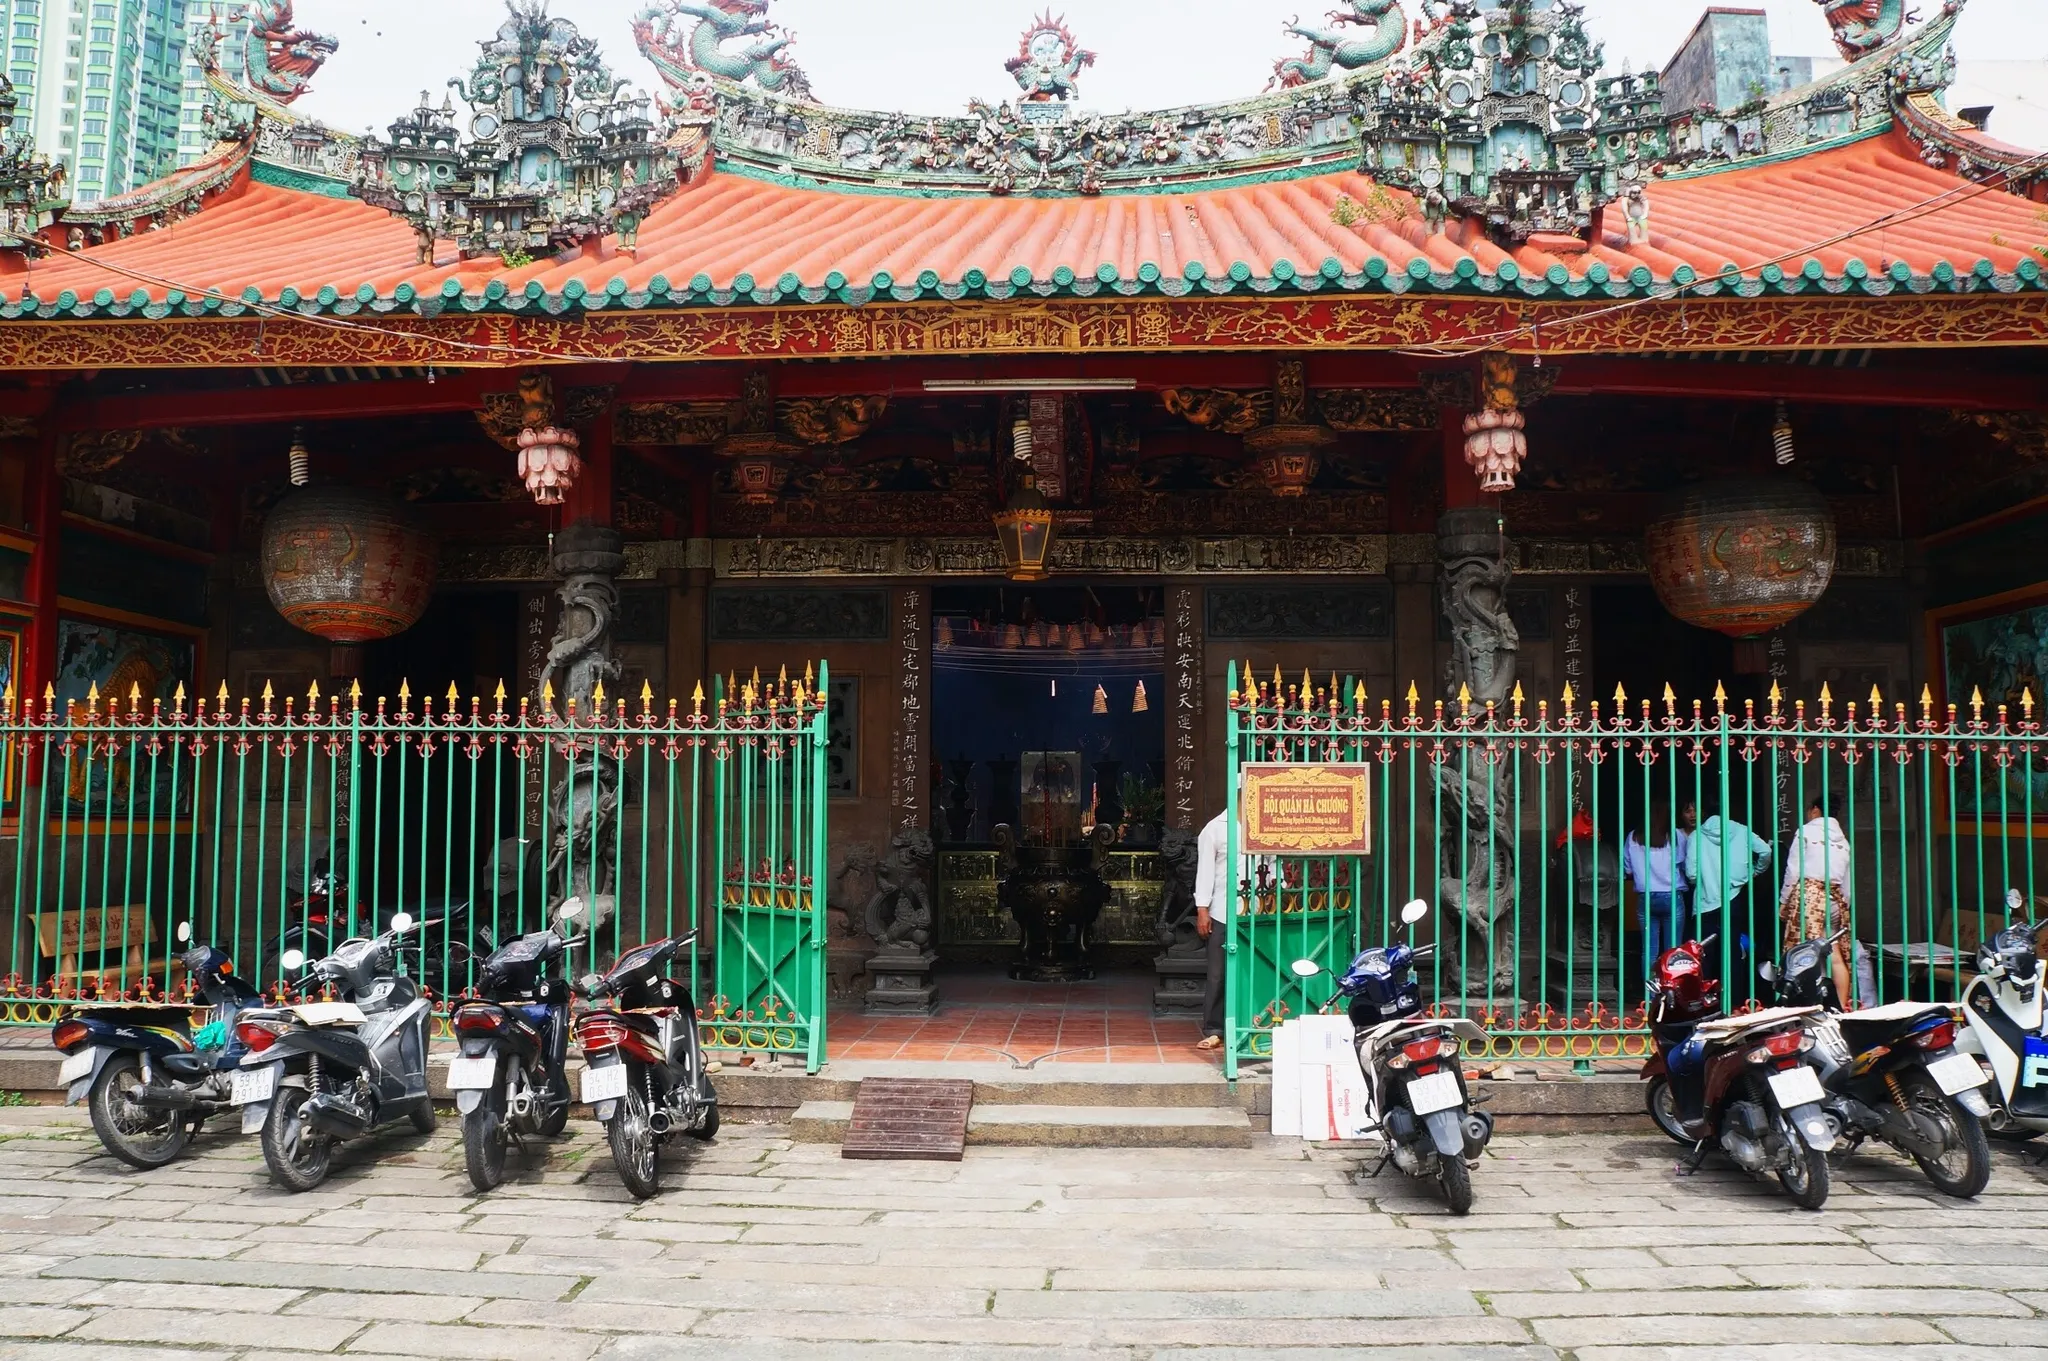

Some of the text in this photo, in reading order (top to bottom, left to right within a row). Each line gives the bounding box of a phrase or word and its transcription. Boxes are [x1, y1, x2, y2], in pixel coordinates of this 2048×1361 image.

[1264, 795, 1349, 816] HỘI QUÁN HÀ CHƯƠNG
